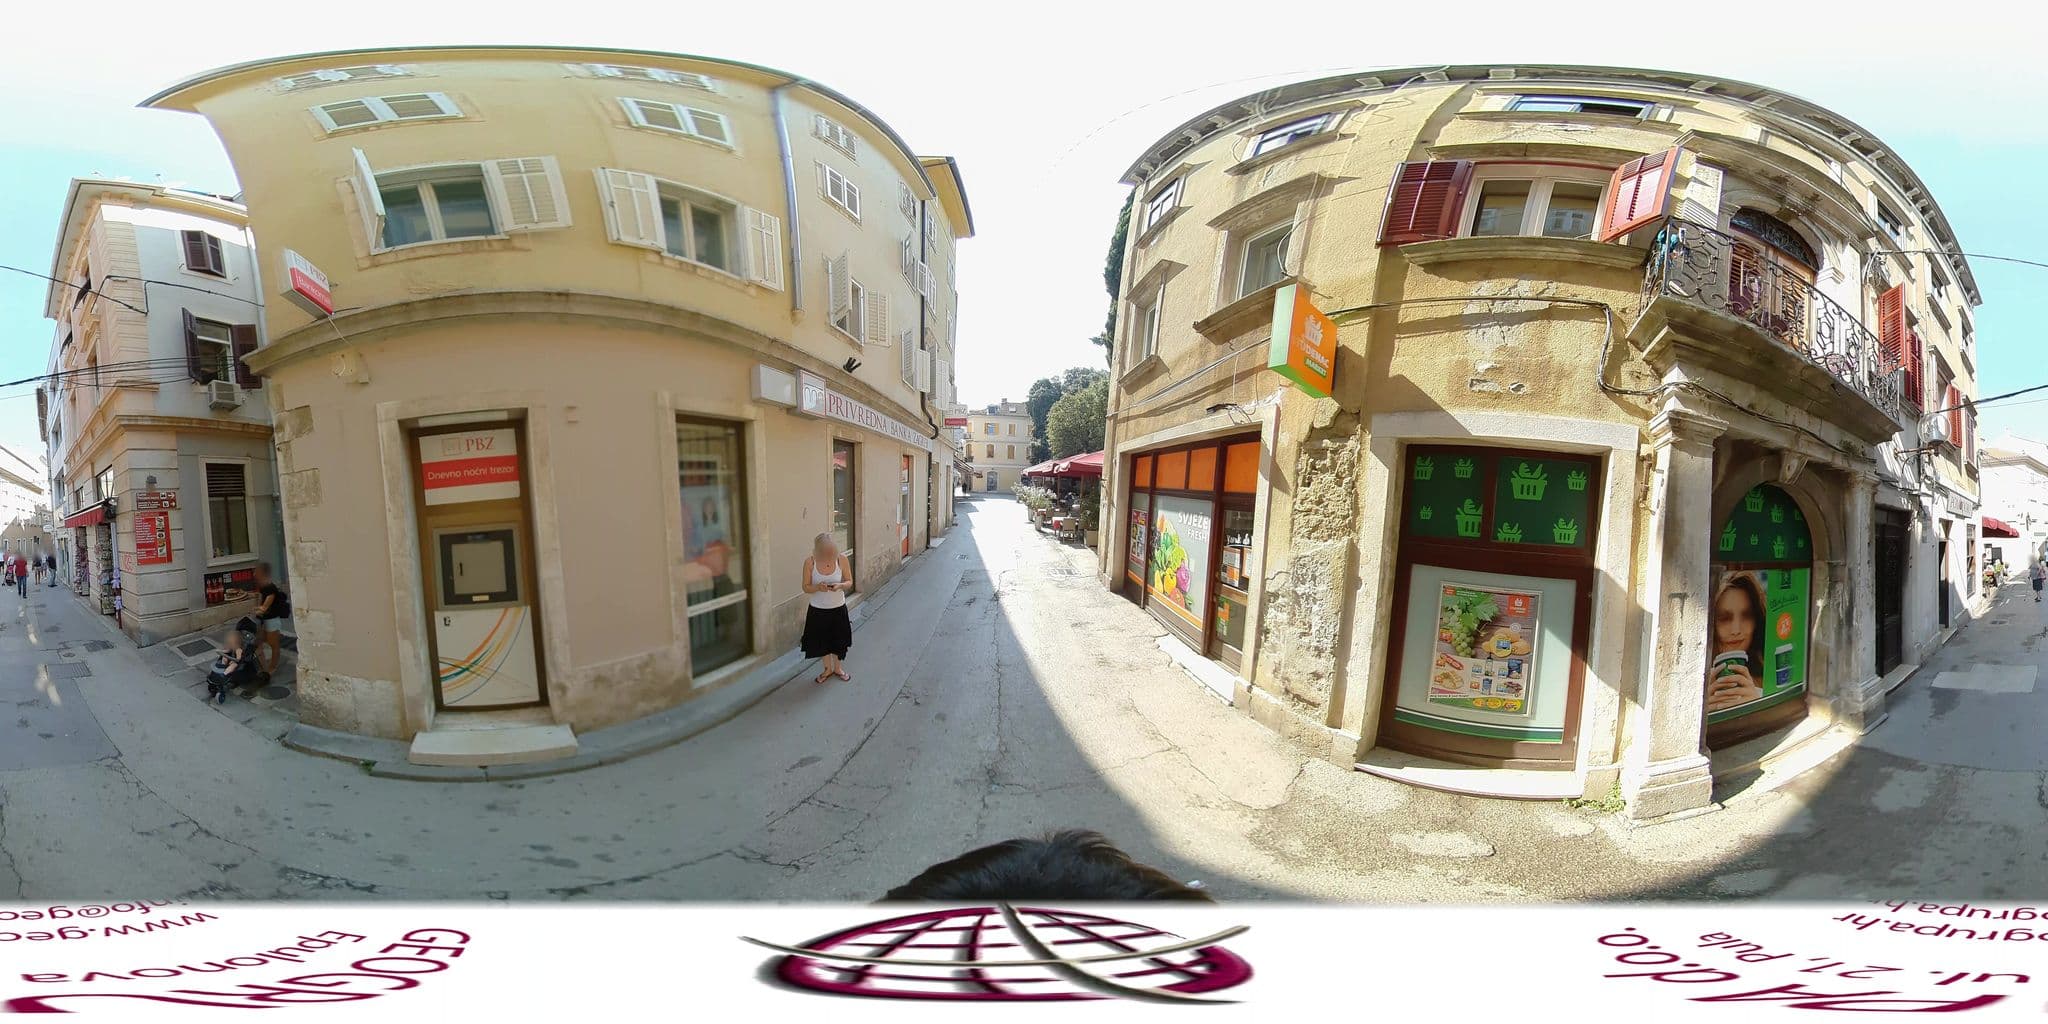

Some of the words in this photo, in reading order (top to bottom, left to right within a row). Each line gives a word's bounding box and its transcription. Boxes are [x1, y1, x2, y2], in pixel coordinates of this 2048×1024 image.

[828, 393, 888, 433] PRIVREDNA
[890, 421, 912, 443] BANKA
[465, 436, 495, 452] PBZ
[428, 470, 461, 481] Dnevno
[490, 465, 514, 474] trezor
[1178, 511, 1209, 531] SVJEŽE
[1187, 528, 1207, 542] FRESH
